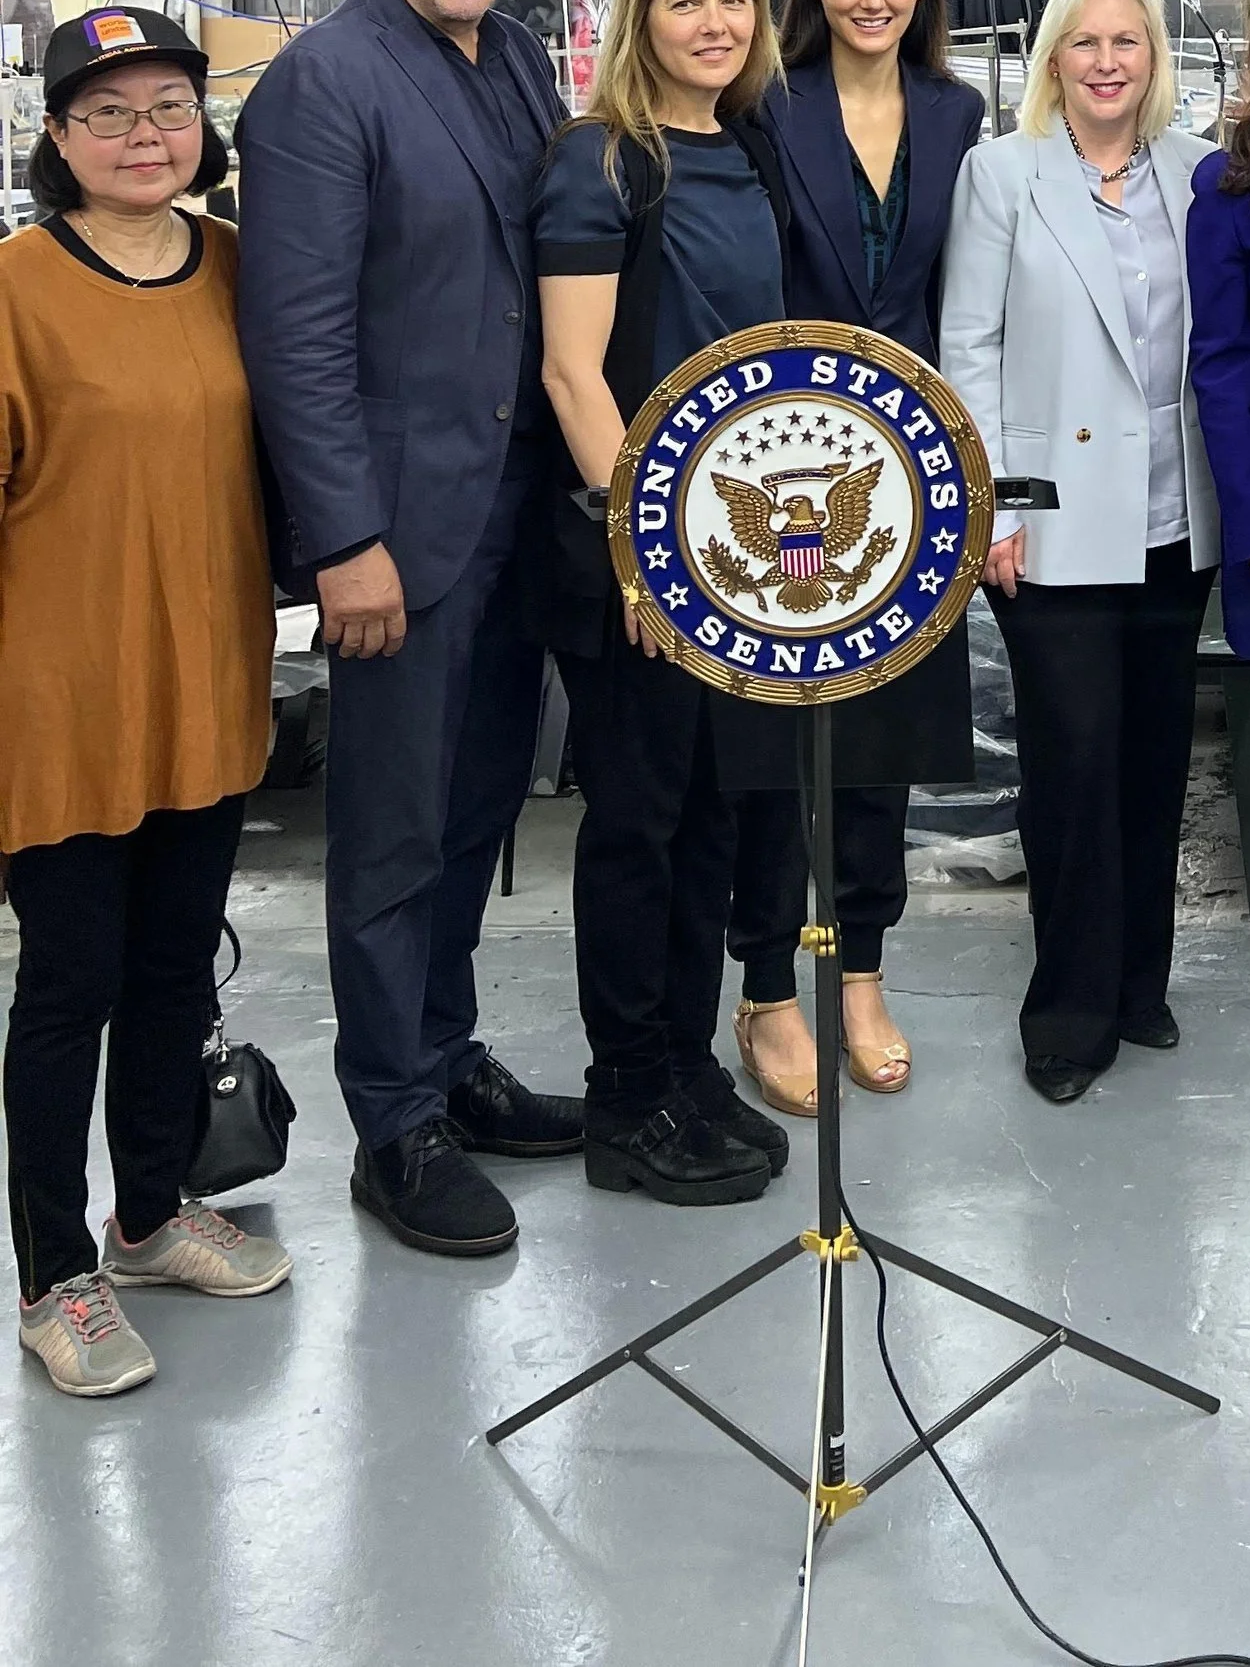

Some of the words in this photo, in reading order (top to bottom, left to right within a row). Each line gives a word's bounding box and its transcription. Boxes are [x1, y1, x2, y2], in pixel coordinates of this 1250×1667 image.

[637, 360, 774, 534] UNITED
[810, 355, 960, 511] STATES
[693, 603, 914, 675] SENATE
